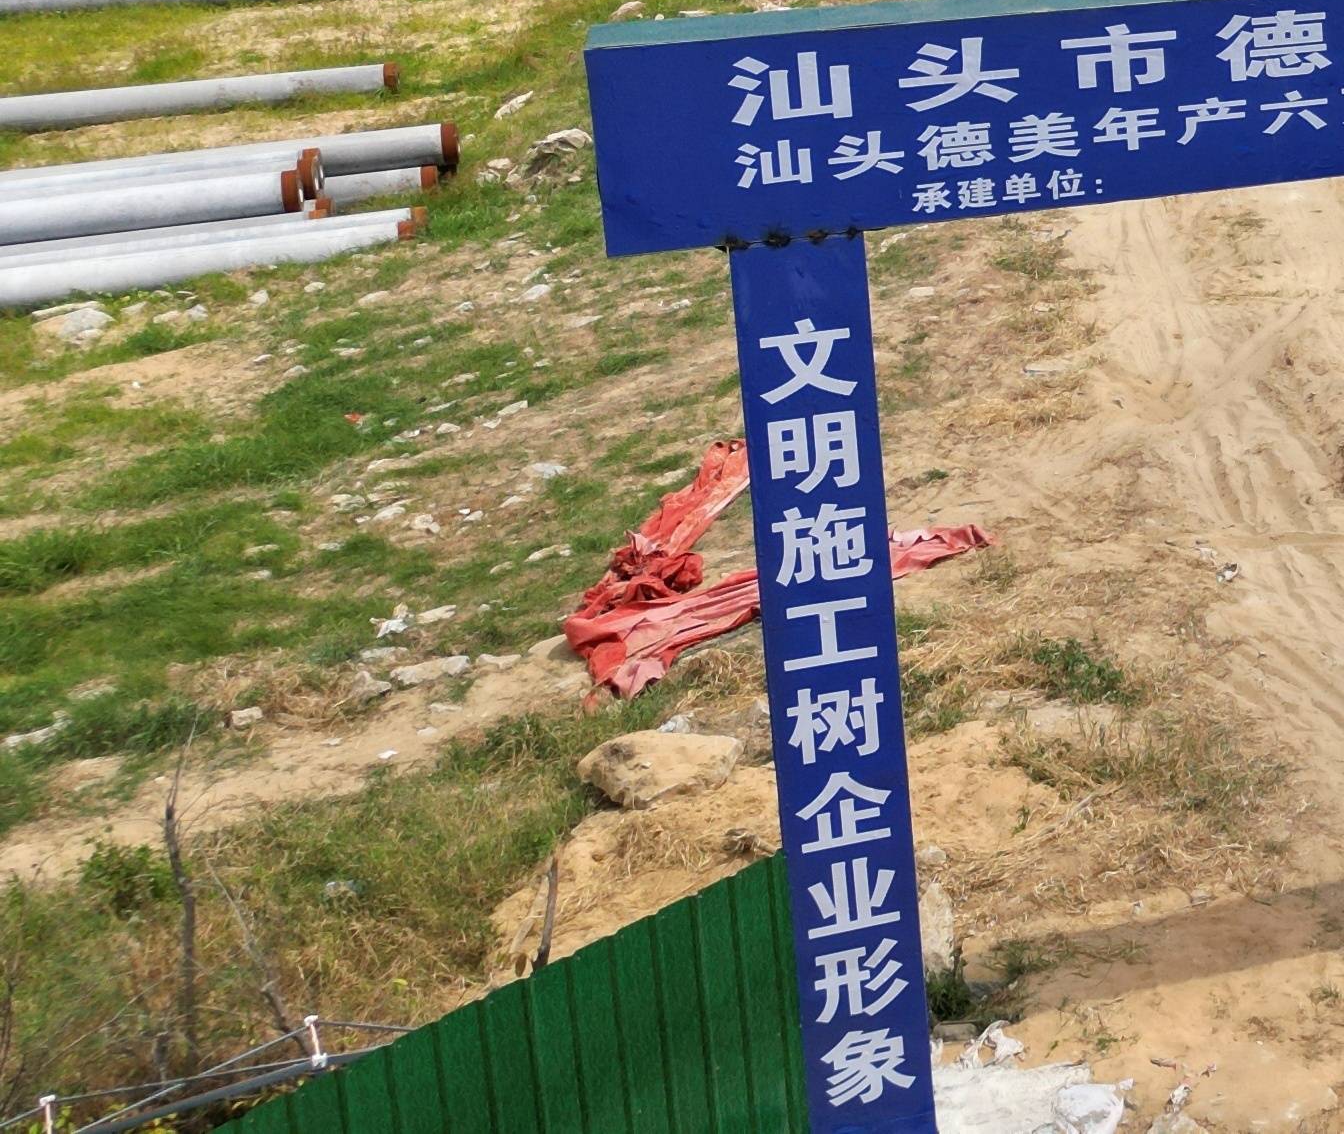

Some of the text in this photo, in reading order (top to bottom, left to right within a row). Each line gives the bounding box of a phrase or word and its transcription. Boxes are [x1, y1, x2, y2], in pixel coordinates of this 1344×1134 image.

[759, 318, 917, 1108] 文明施工树企业形象
